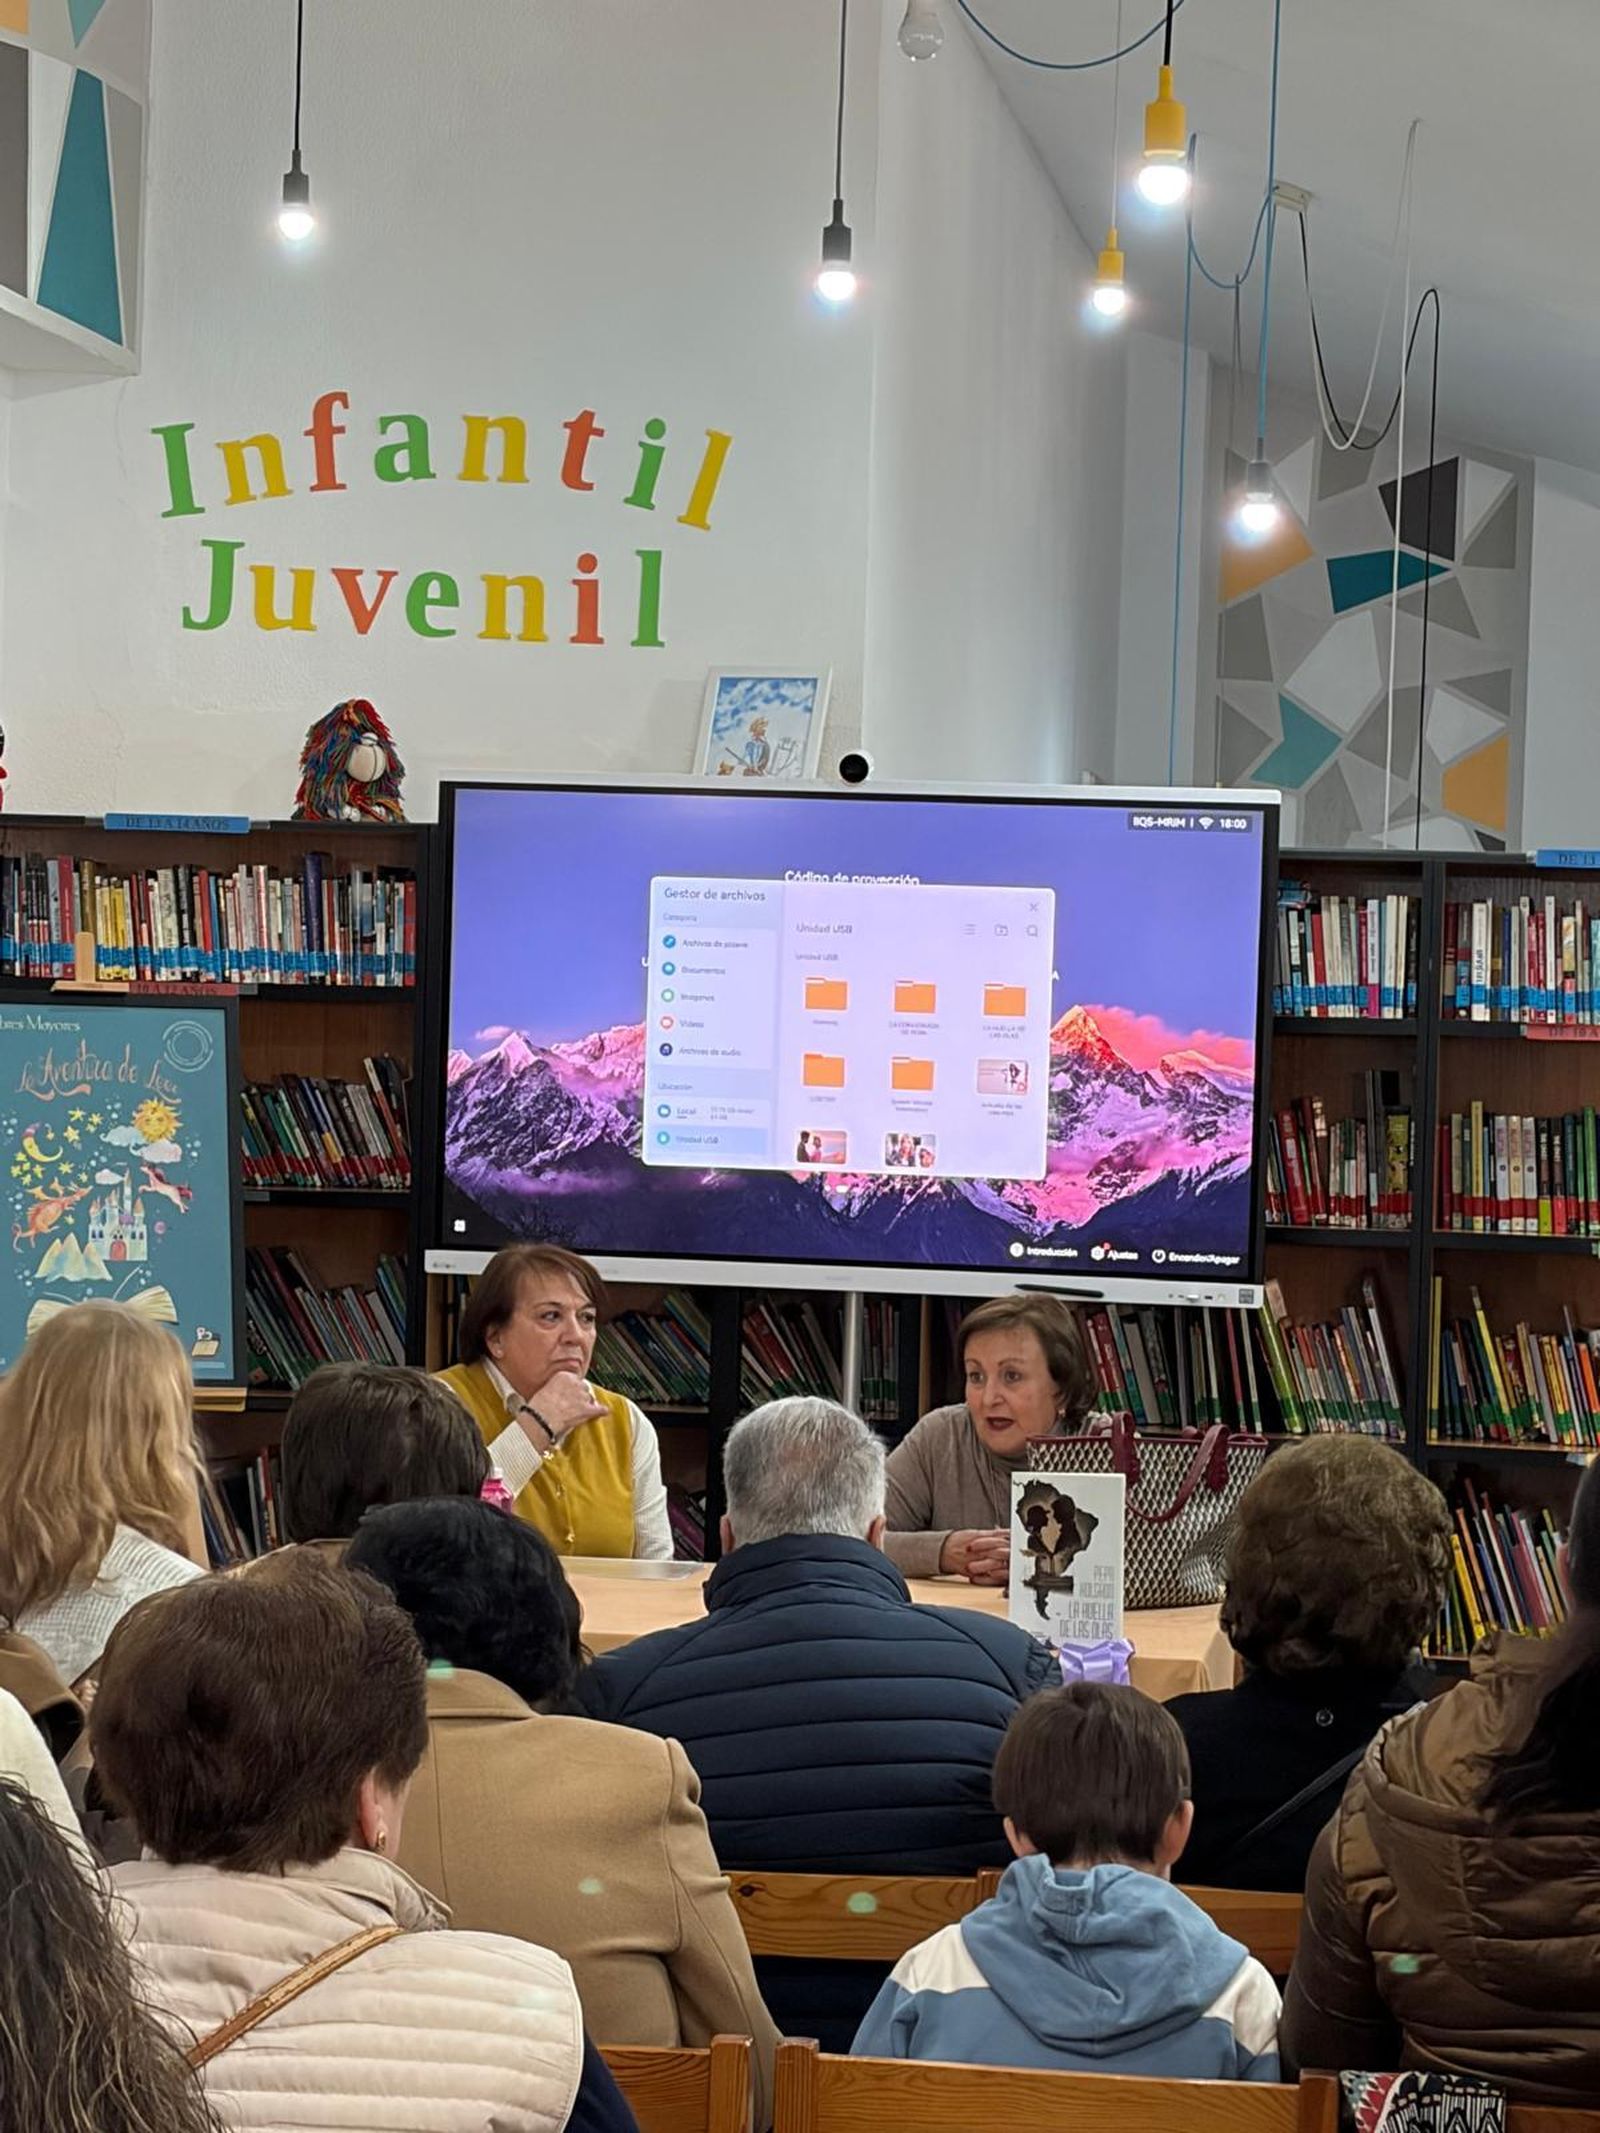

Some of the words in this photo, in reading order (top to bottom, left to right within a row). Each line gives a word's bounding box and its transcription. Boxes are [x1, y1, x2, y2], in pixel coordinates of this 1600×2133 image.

[150, 392, 731, 530] Infantil
[182, 540, 664, 647] Juvenil
[1220, 818, 1247, 829] 18:00
[664, 887, 700, 899] Gestor
[704, 888, 717, 900] de
[721, 889, 766, 901] archivos
[796, 924, 831, 934] Unidad
[833, 925, 853, 934] USB
[27, 1014, 80, 1034] Mayores
[118, 1043, 138, 1084] de
[703, 1136, 719, 1144] USB
[1107, 1249, 1138, 1261] Ajustes
[1068, 1600, 1080, 1619] LA
[1060, 1619, 1069, 1638] DE
[1073, 1620, 1089, 1638] LAS
